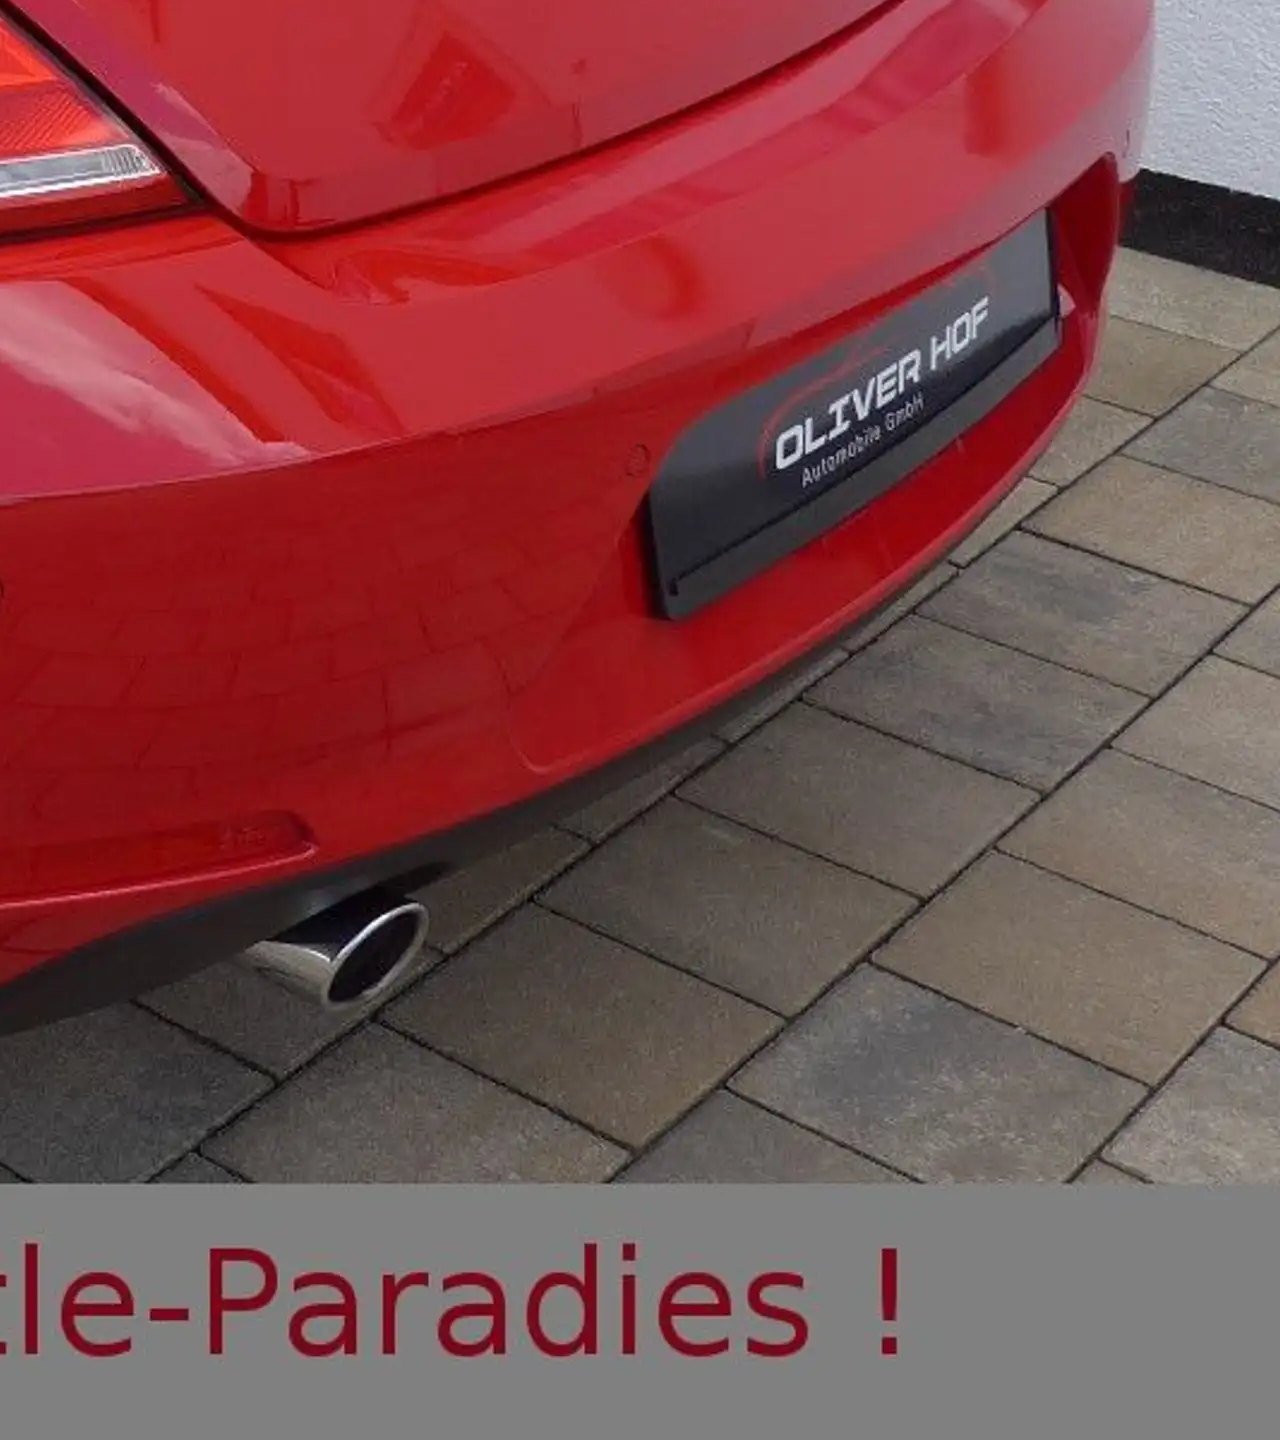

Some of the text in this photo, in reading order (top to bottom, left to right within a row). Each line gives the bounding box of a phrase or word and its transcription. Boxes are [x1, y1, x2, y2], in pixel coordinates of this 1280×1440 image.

[776, 296, 989, 470] OLIVER HOF
[802, 391, 923, 489] Automobile GmbH
